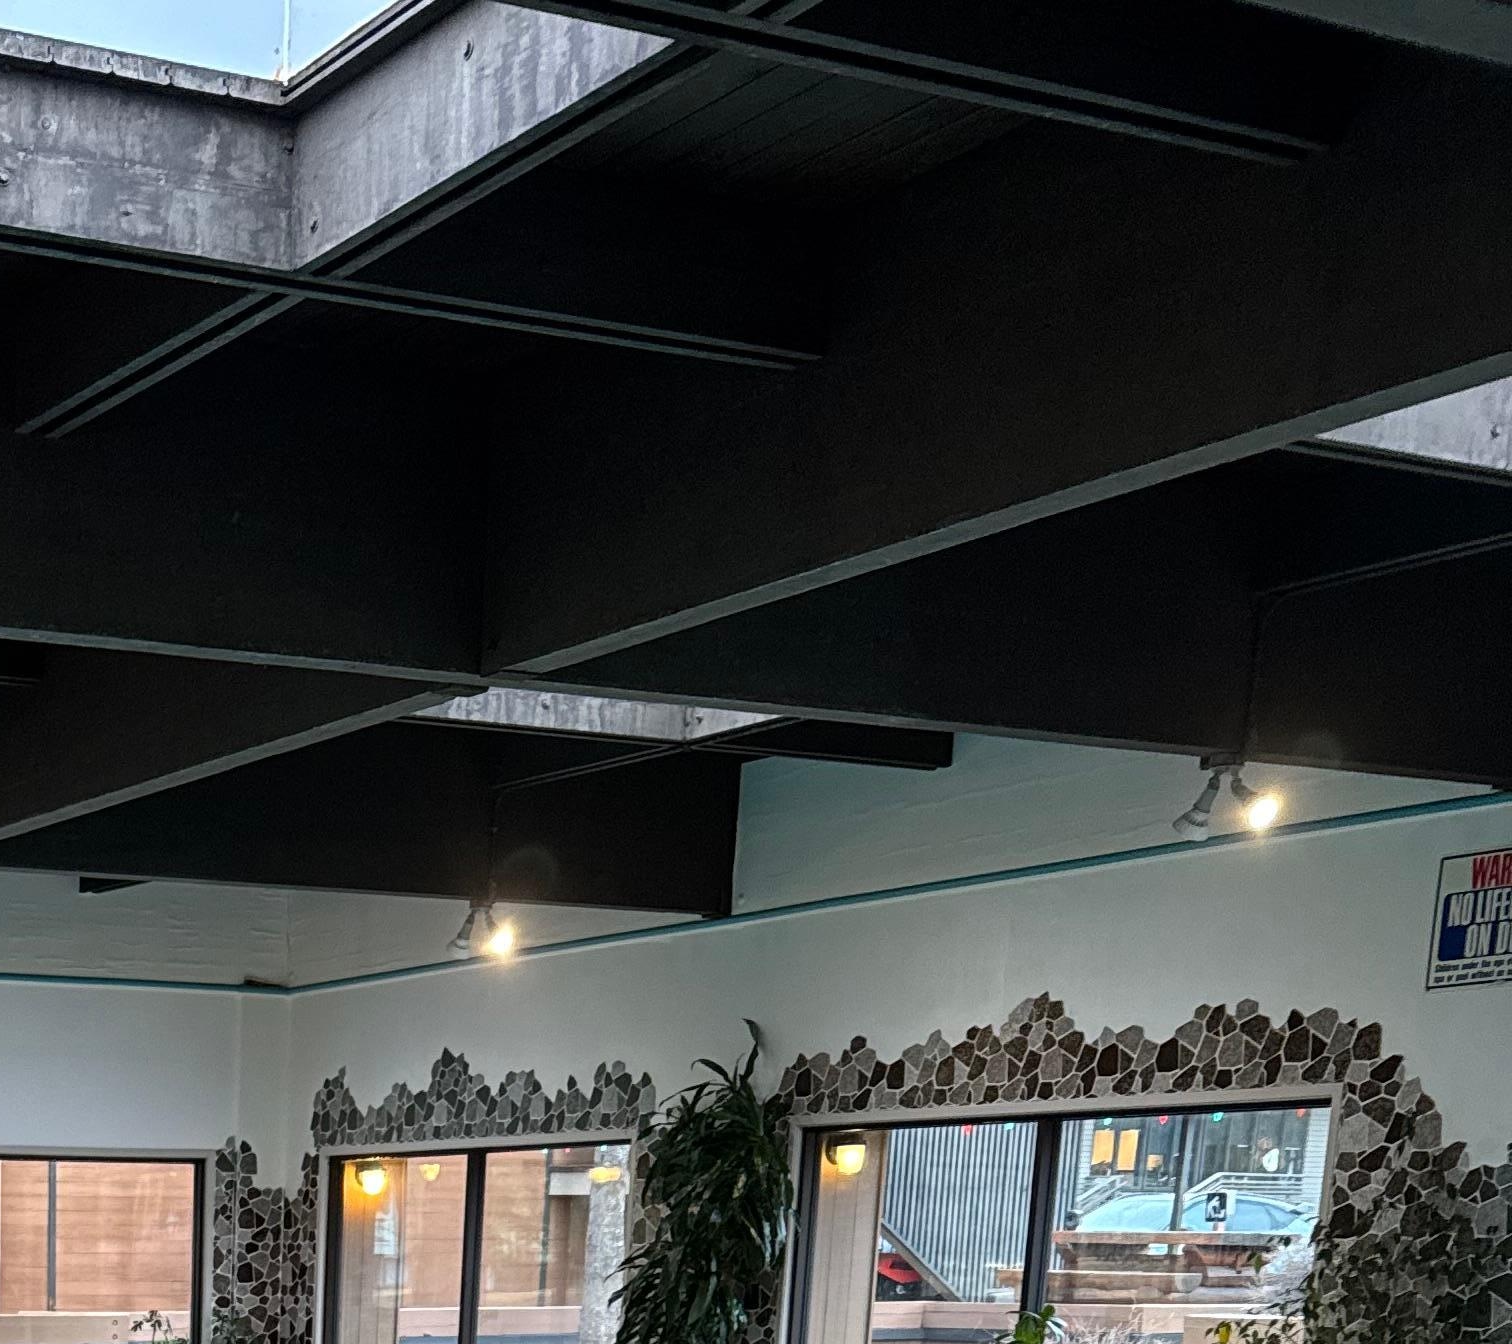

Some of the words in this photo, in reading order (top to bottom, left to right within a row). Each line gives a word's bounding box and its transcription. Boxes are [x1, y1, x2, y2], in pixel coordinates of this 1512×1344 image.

[1447, 892, 1475, 928] NO
[1476, 887, 1512, 923] LIFE
[1463, 922, 1492, 957] ON
